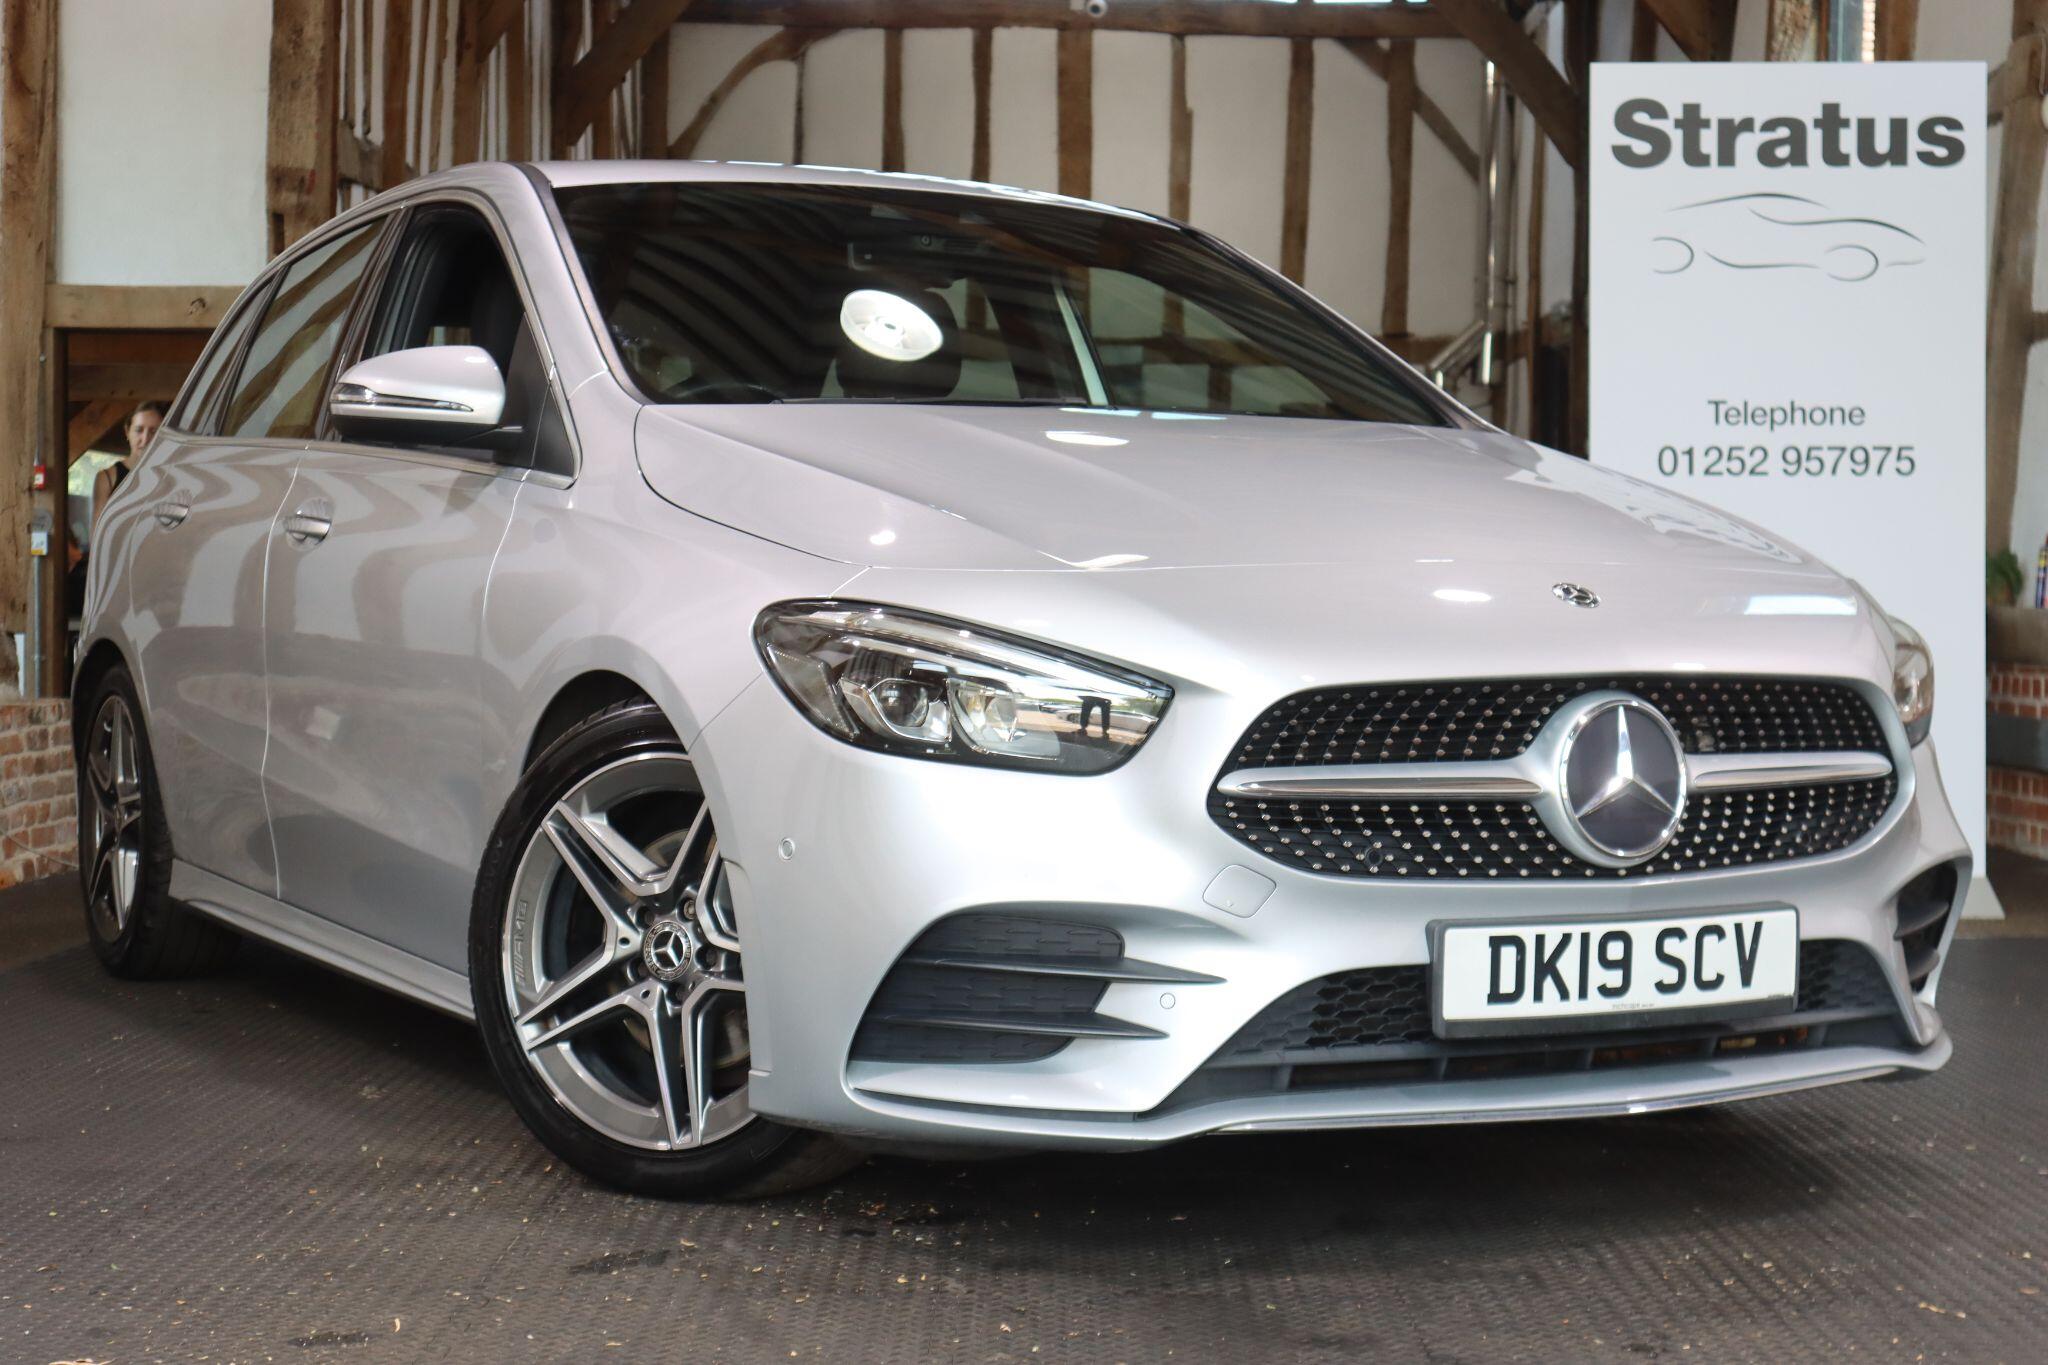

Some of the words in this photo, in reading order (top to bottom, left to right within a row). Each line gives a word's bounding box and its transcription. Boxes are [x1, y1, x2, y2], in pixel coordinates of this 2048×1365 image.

[1611, 98, 1966, 169] Stratus
[1707, 400, 1866, 432] Telephone
[1657, 445, 1769, 477] 01252
[1781, 445, 1916, 477] 957975
[1487, 930, 1633, 1006] DK19
[1654, 921, 1764, 994] SCV
